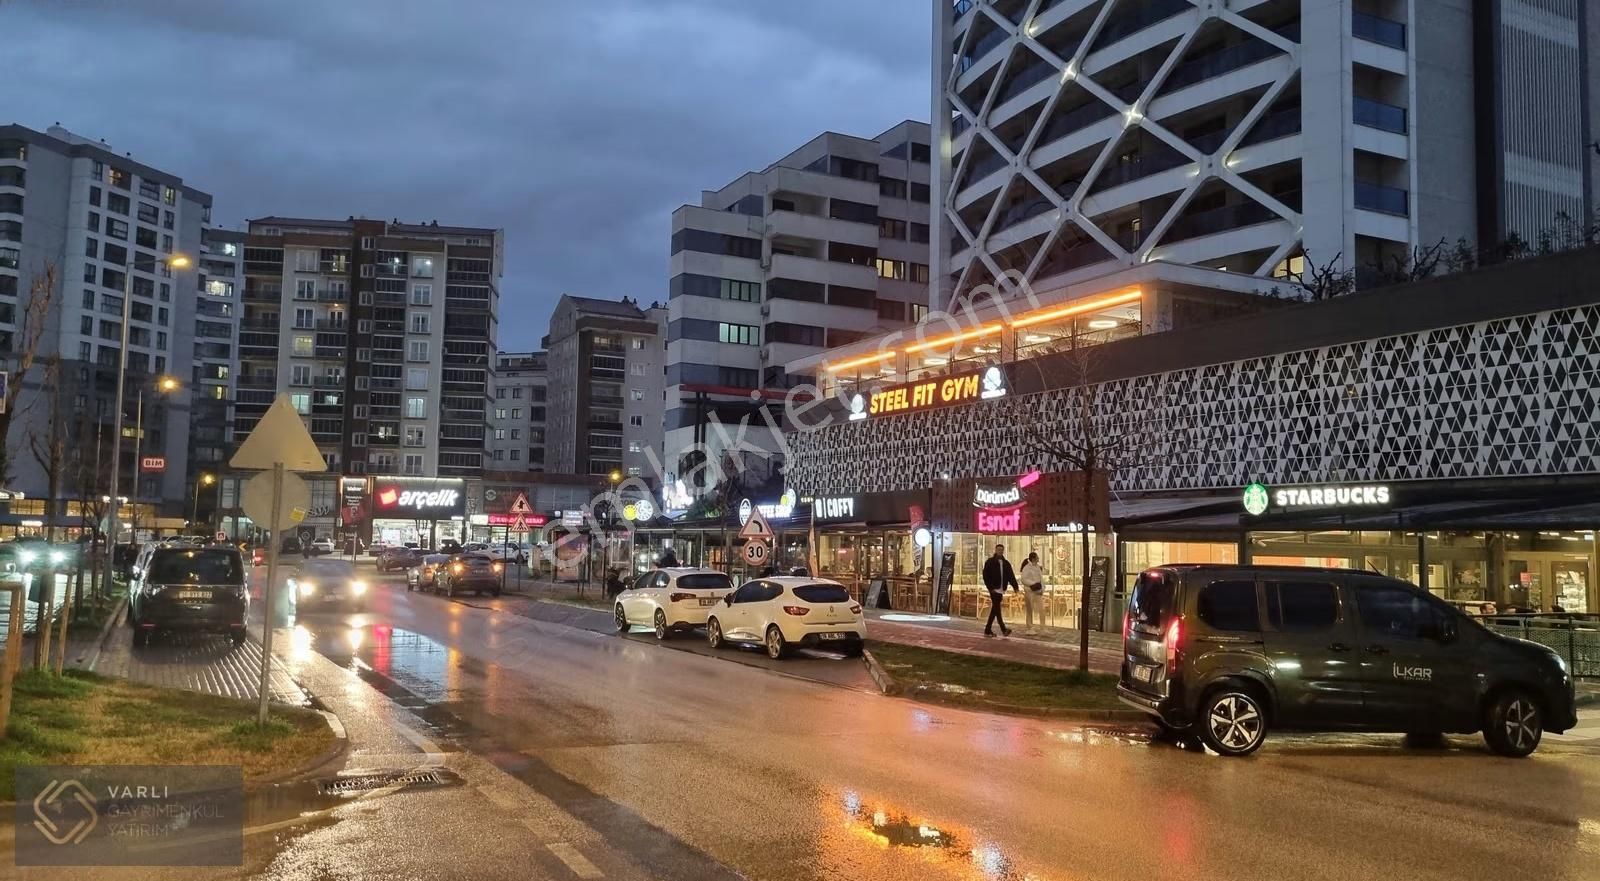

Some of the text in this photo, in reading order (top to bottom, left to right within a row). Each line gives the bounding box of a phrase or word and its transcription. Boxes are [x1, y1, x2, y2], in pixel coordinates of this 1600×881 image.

[870, 375, 979, 413] STEEL FIT GYM
[398, 489, 459, 510] arçelik
[1276, 487, 1390, 506] STARBUCKS
[827, 497, 854, 518] COFFY
[978, 509, 1020, 531] Esnaf
[748, 546, 763, 558] 30
